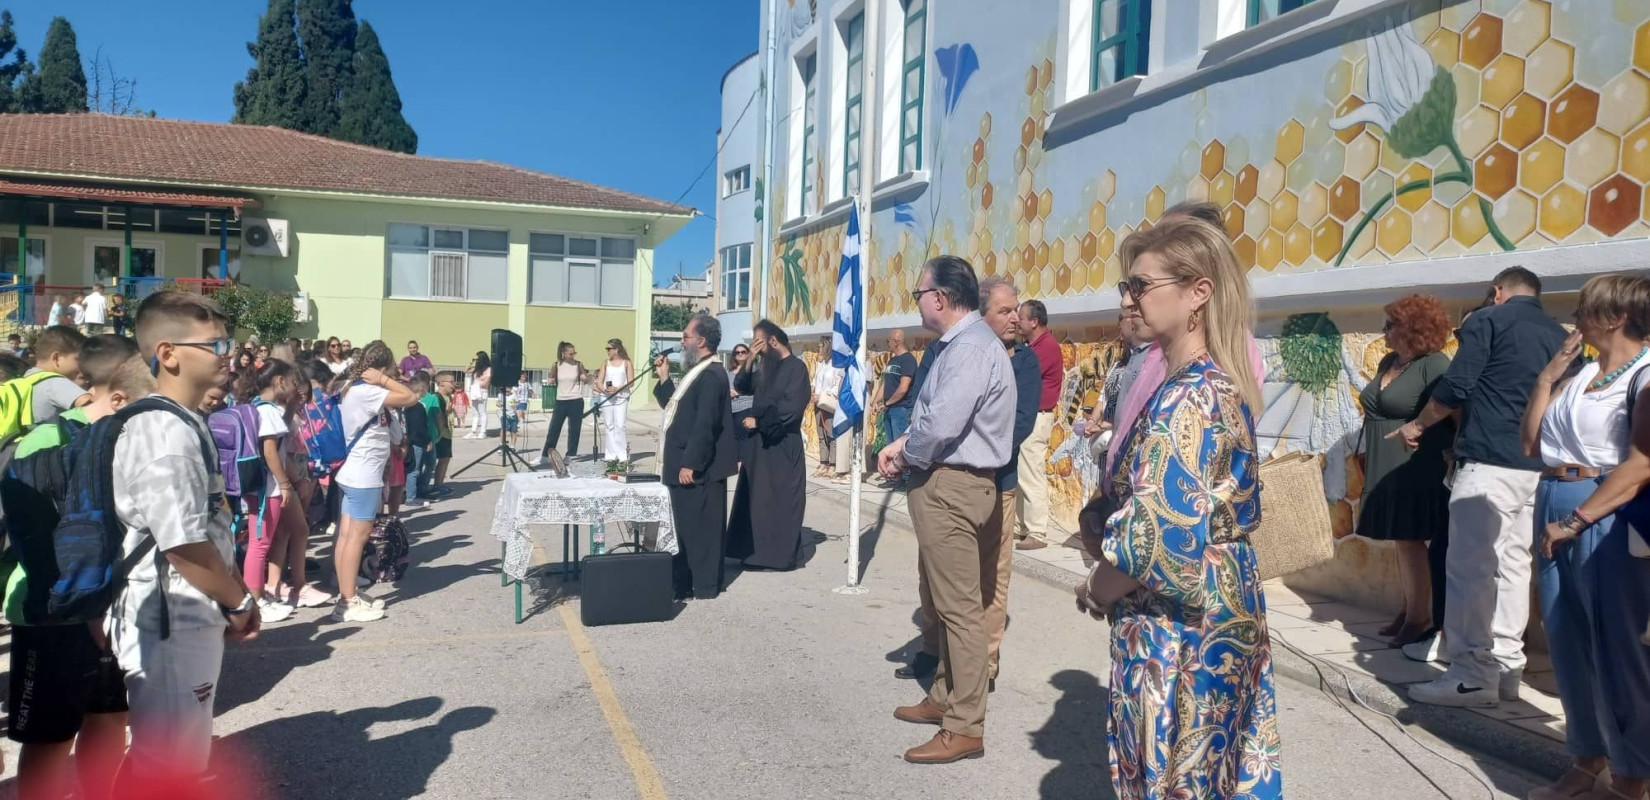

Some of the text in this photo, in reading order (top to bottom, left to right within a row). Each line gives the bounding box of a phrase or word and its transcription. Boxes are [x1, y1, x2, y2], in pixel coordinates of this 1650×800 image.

[16, 649, 37, 731] BEAT THE FEAR
